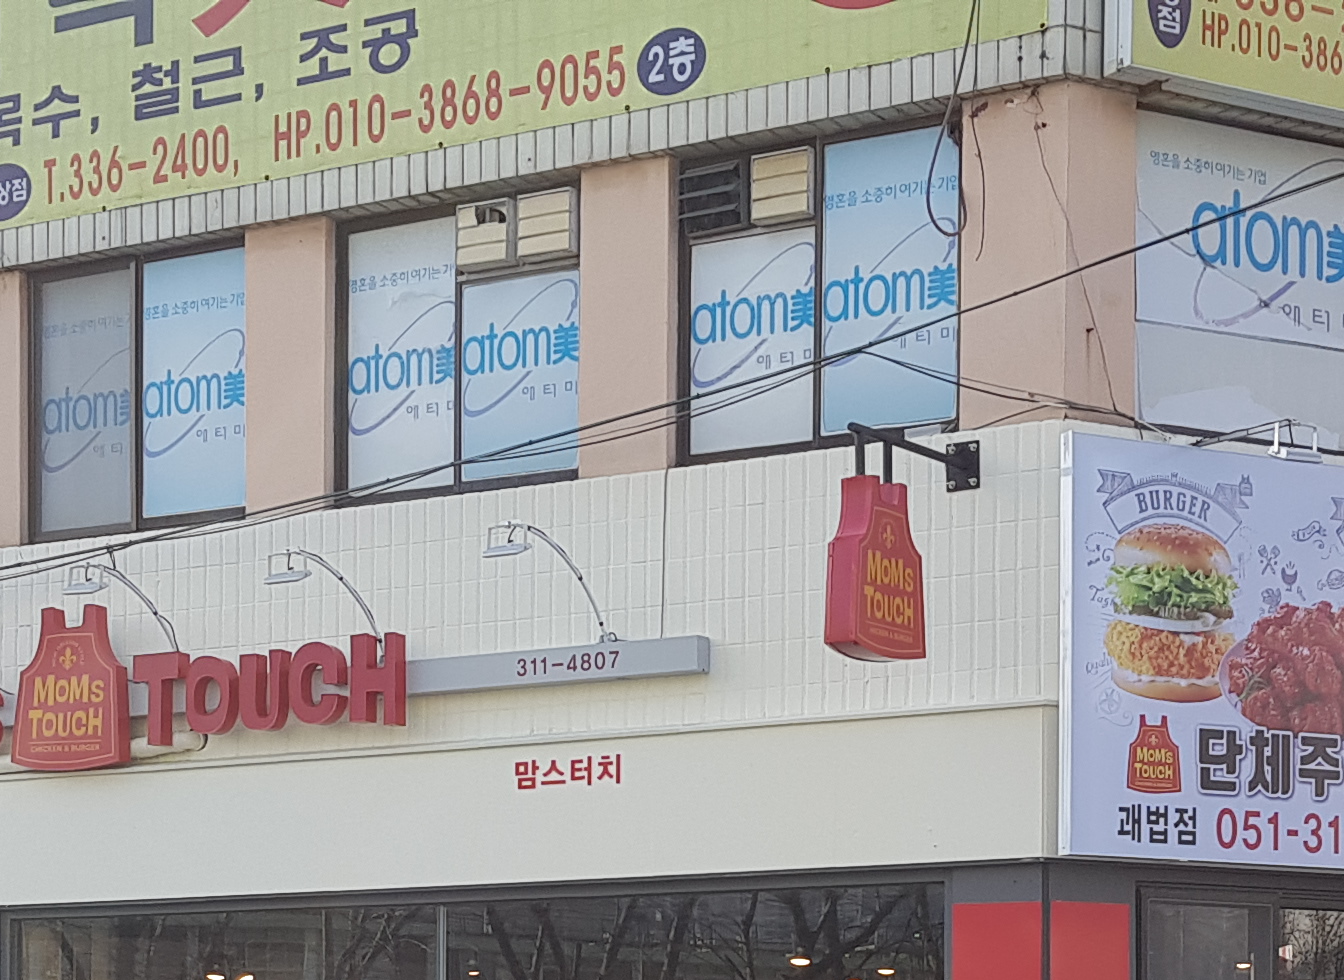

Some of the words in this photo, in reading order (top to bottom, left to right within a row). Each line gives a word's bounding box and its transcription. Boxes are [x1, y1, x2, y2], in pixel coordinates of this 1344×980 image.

[296, 8, 419, 87] 조공
[648, 36, 696, 84] 2층
[273, 45, 625, 162] HP.010-3868-9055
[1150, 150, 1181, 170] 영혼을
[1248, 168, 1267, 186] 기업
[1135, 489, 1211, 523] BURGER
[864, 585, 914, 628] TOUCH
[515, 649, 620, 678] 311-4807
[134, 632, 406, 747] TOUCH
[28, 707, 103, 739] TOUCH
[514, 755, 622, 789] 맘스터치
[1134, 762, 1173, 780] TOUCH
[1117, 804, 1198, 846] 괘법점
